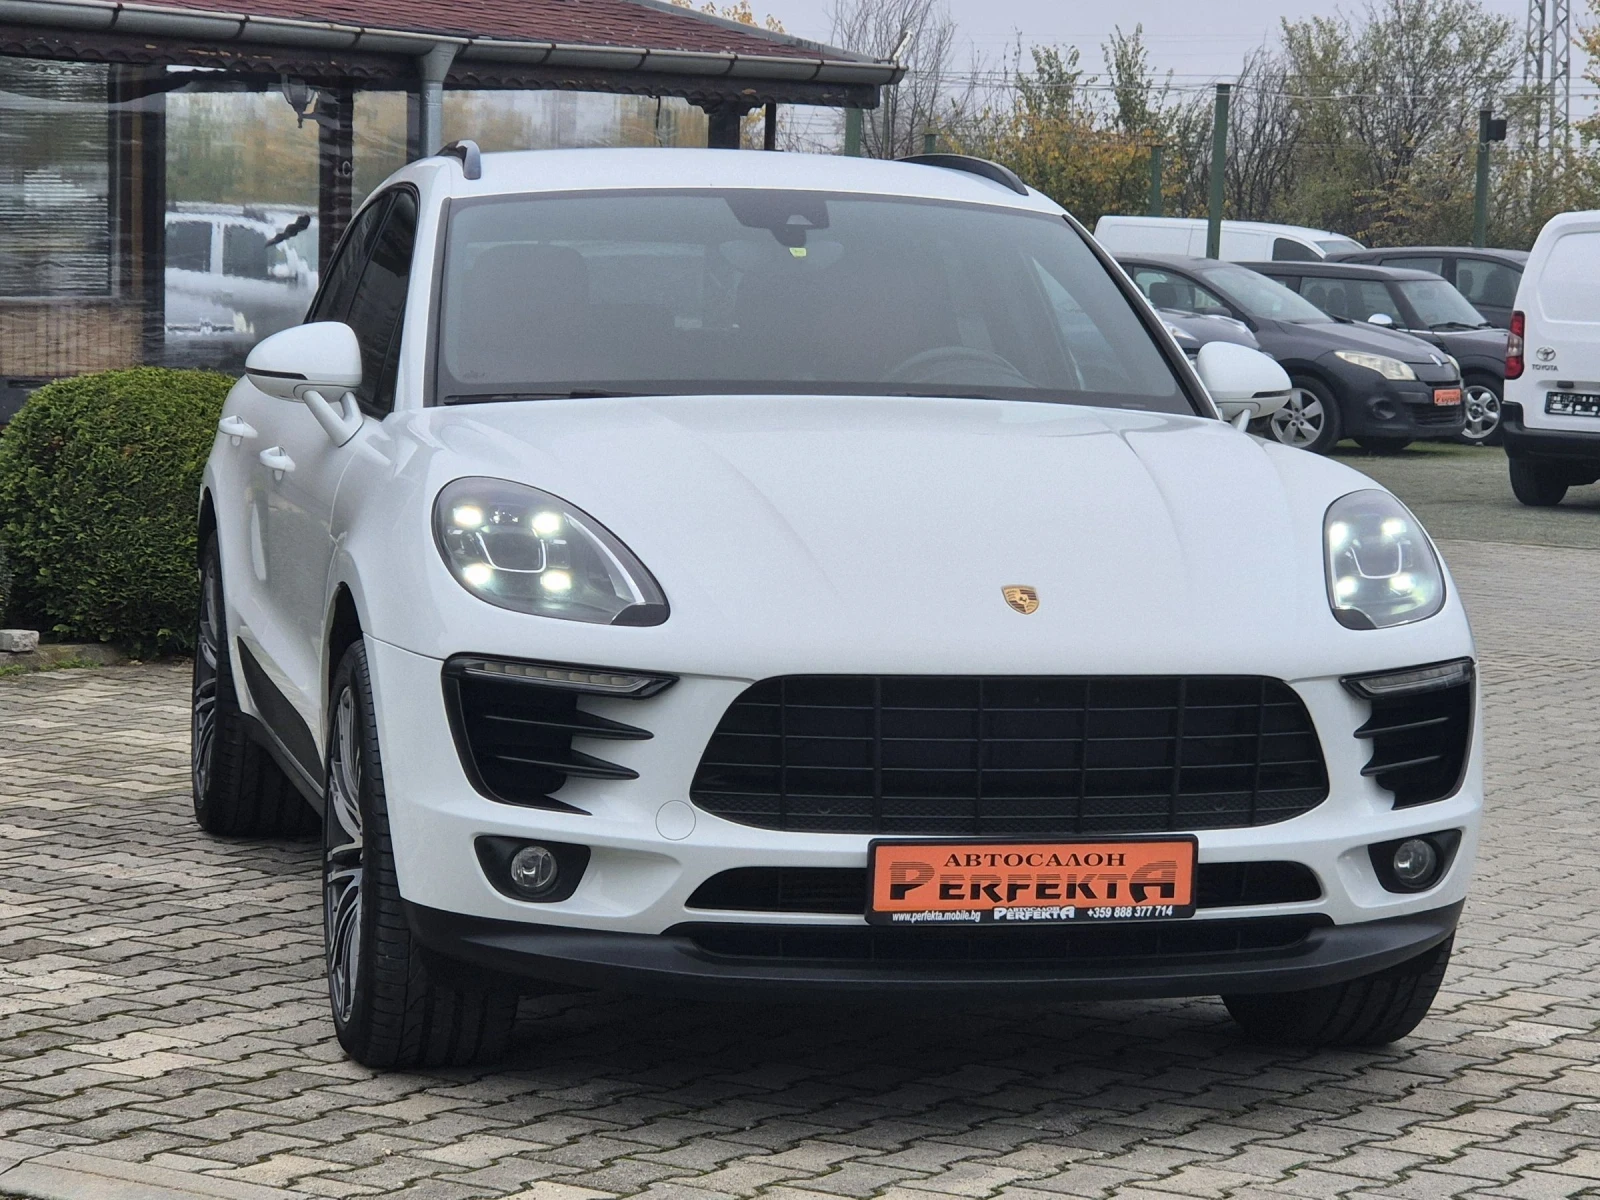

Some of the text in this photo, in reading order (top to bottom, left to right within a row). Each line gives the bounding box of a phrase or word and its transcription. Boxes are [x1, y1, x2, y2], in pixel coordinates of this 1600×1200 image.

[943, 852, 1127, 867] АВТОСАЛОН
[889, 860, 1178, 903] PERFEKTA
[892, 910, 981, 923] www.perfekta.mobile.bg
[993, 906, 1075, 920] PERFEKTA
[1087, 905, 1173, 918] +359 888 377 714
